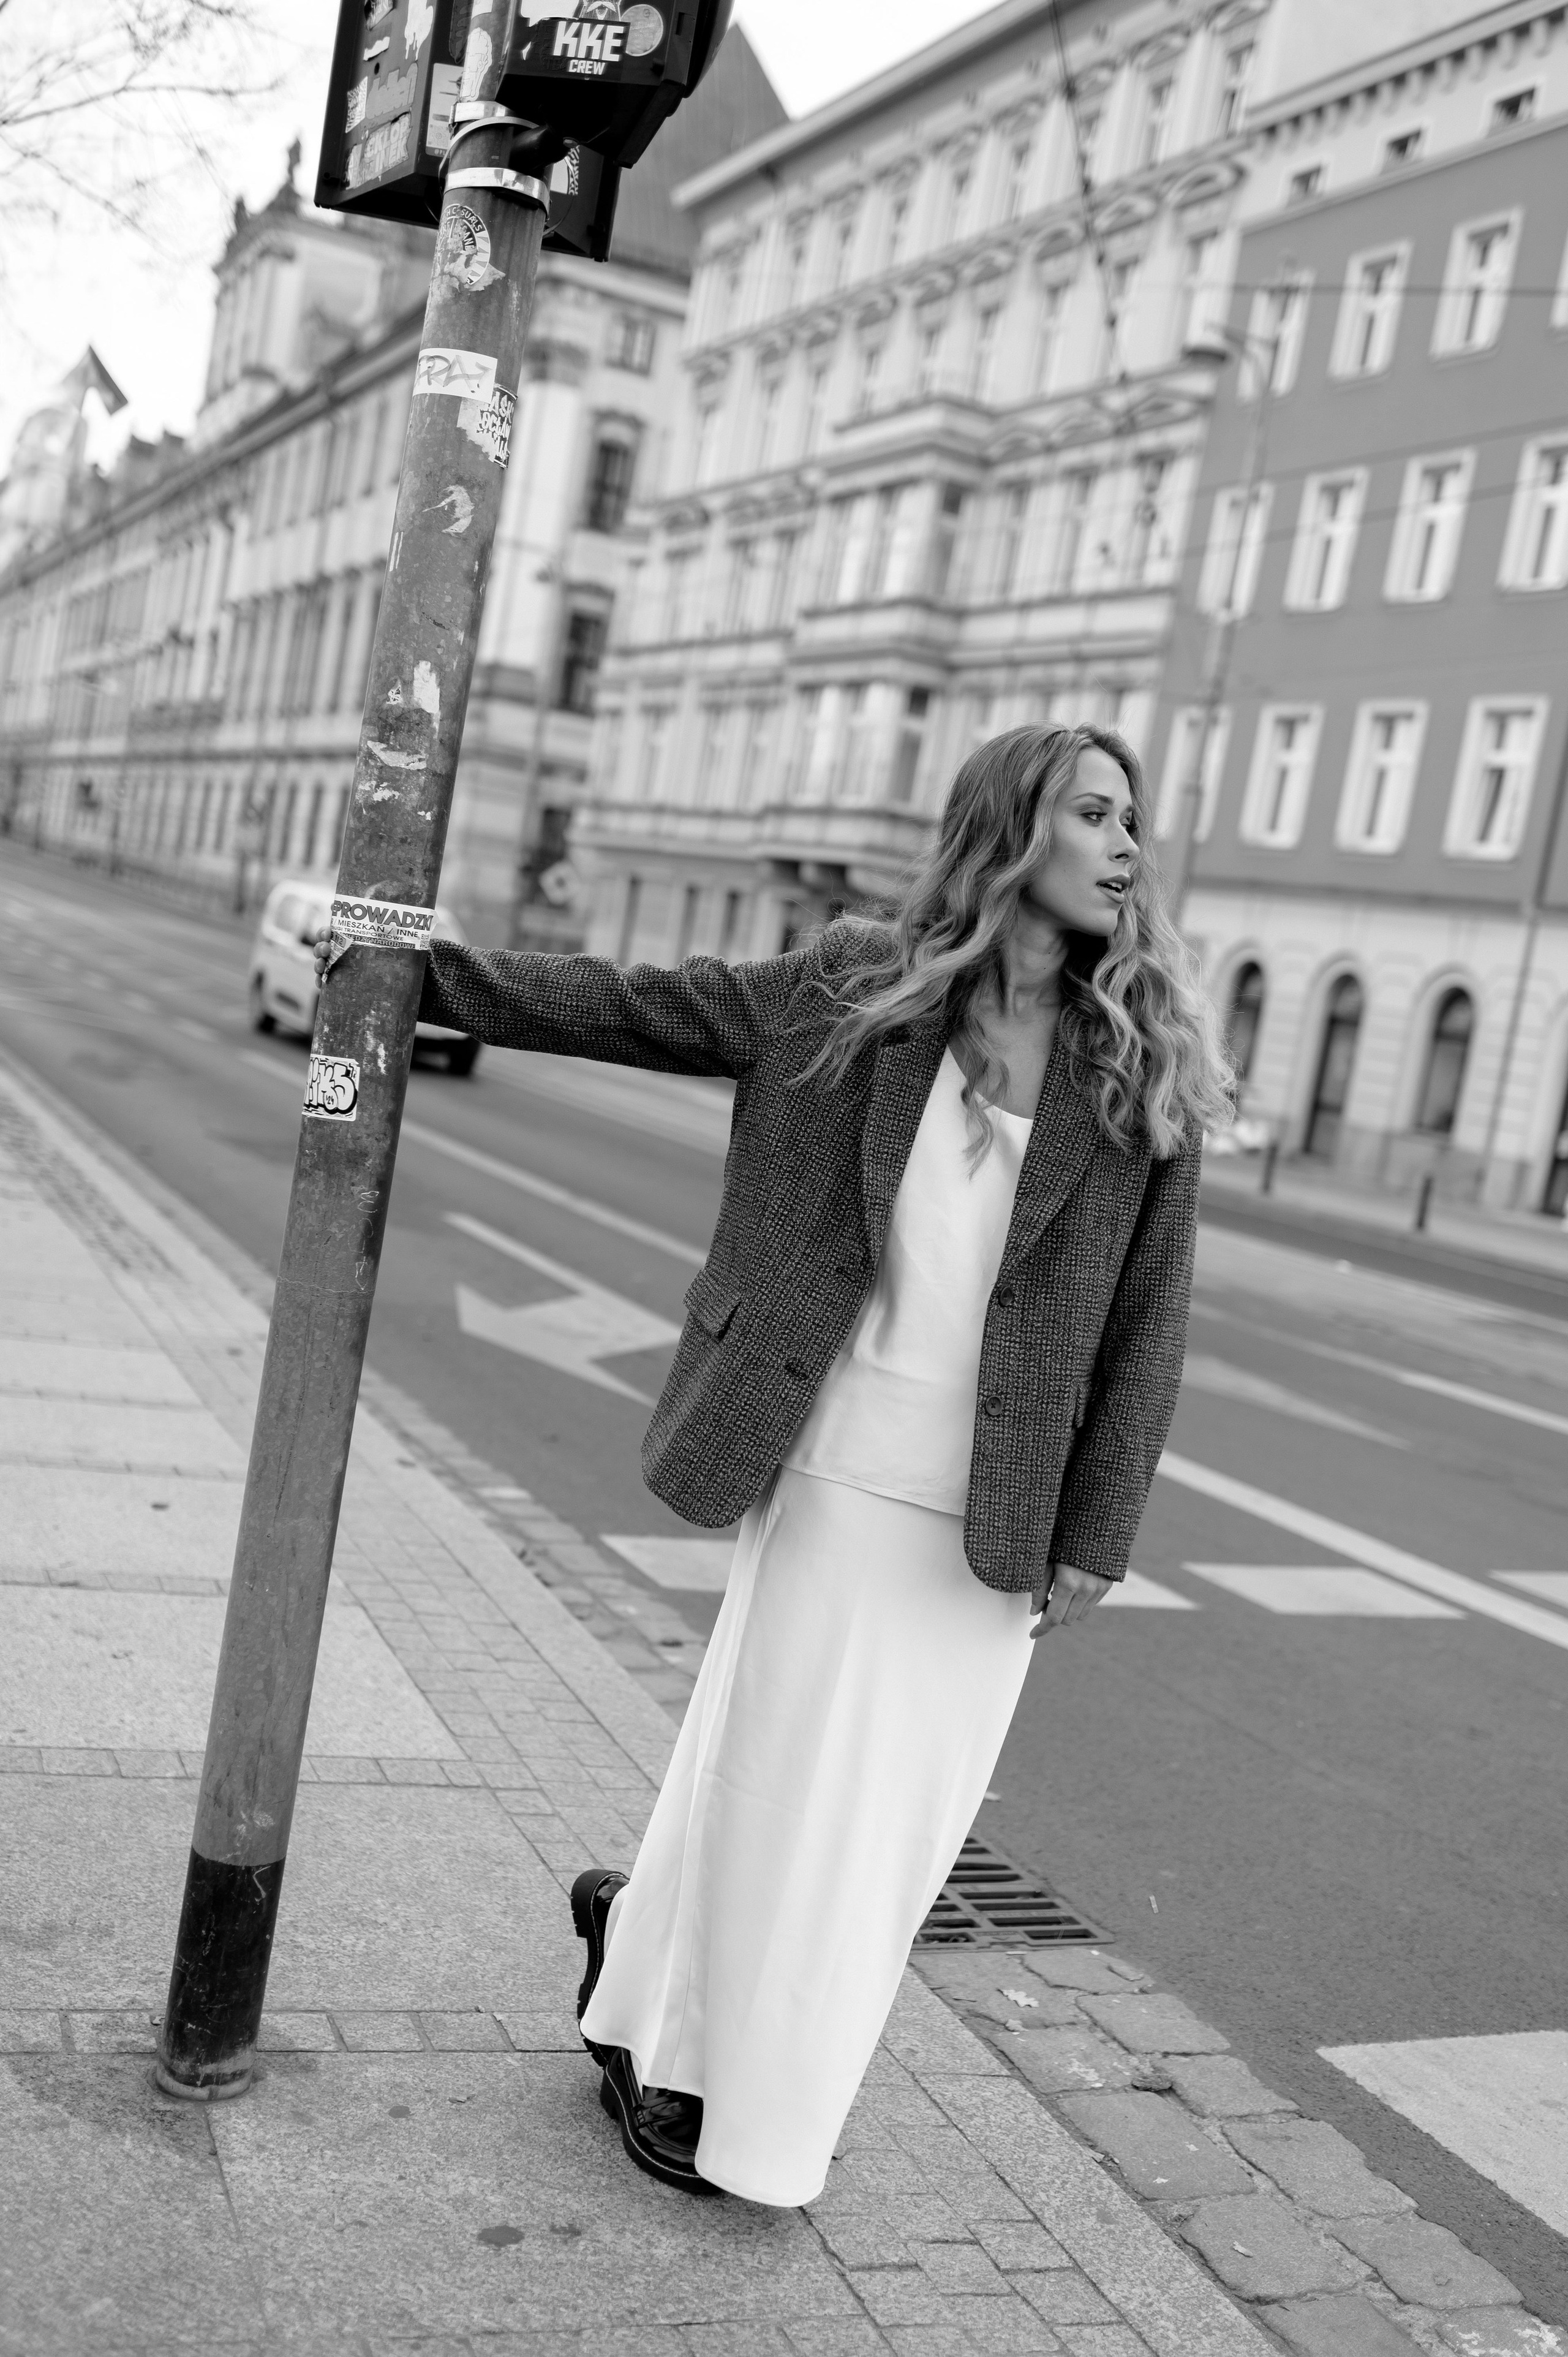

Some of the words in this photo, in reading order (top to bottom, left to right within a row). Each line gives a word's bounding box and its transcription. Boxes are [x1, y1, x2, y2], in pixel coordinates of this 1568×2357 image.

[553, 21, 624, 62] KKE
[568, 59, 606, 75] CREW
[452, 206, 483, 232] CSUALS
[337, 919, 385, 933] MIESZKAŃ
[397, 929, 418, 937] INNE
[345, 928, 404, 941] TRANSPORTOWE
